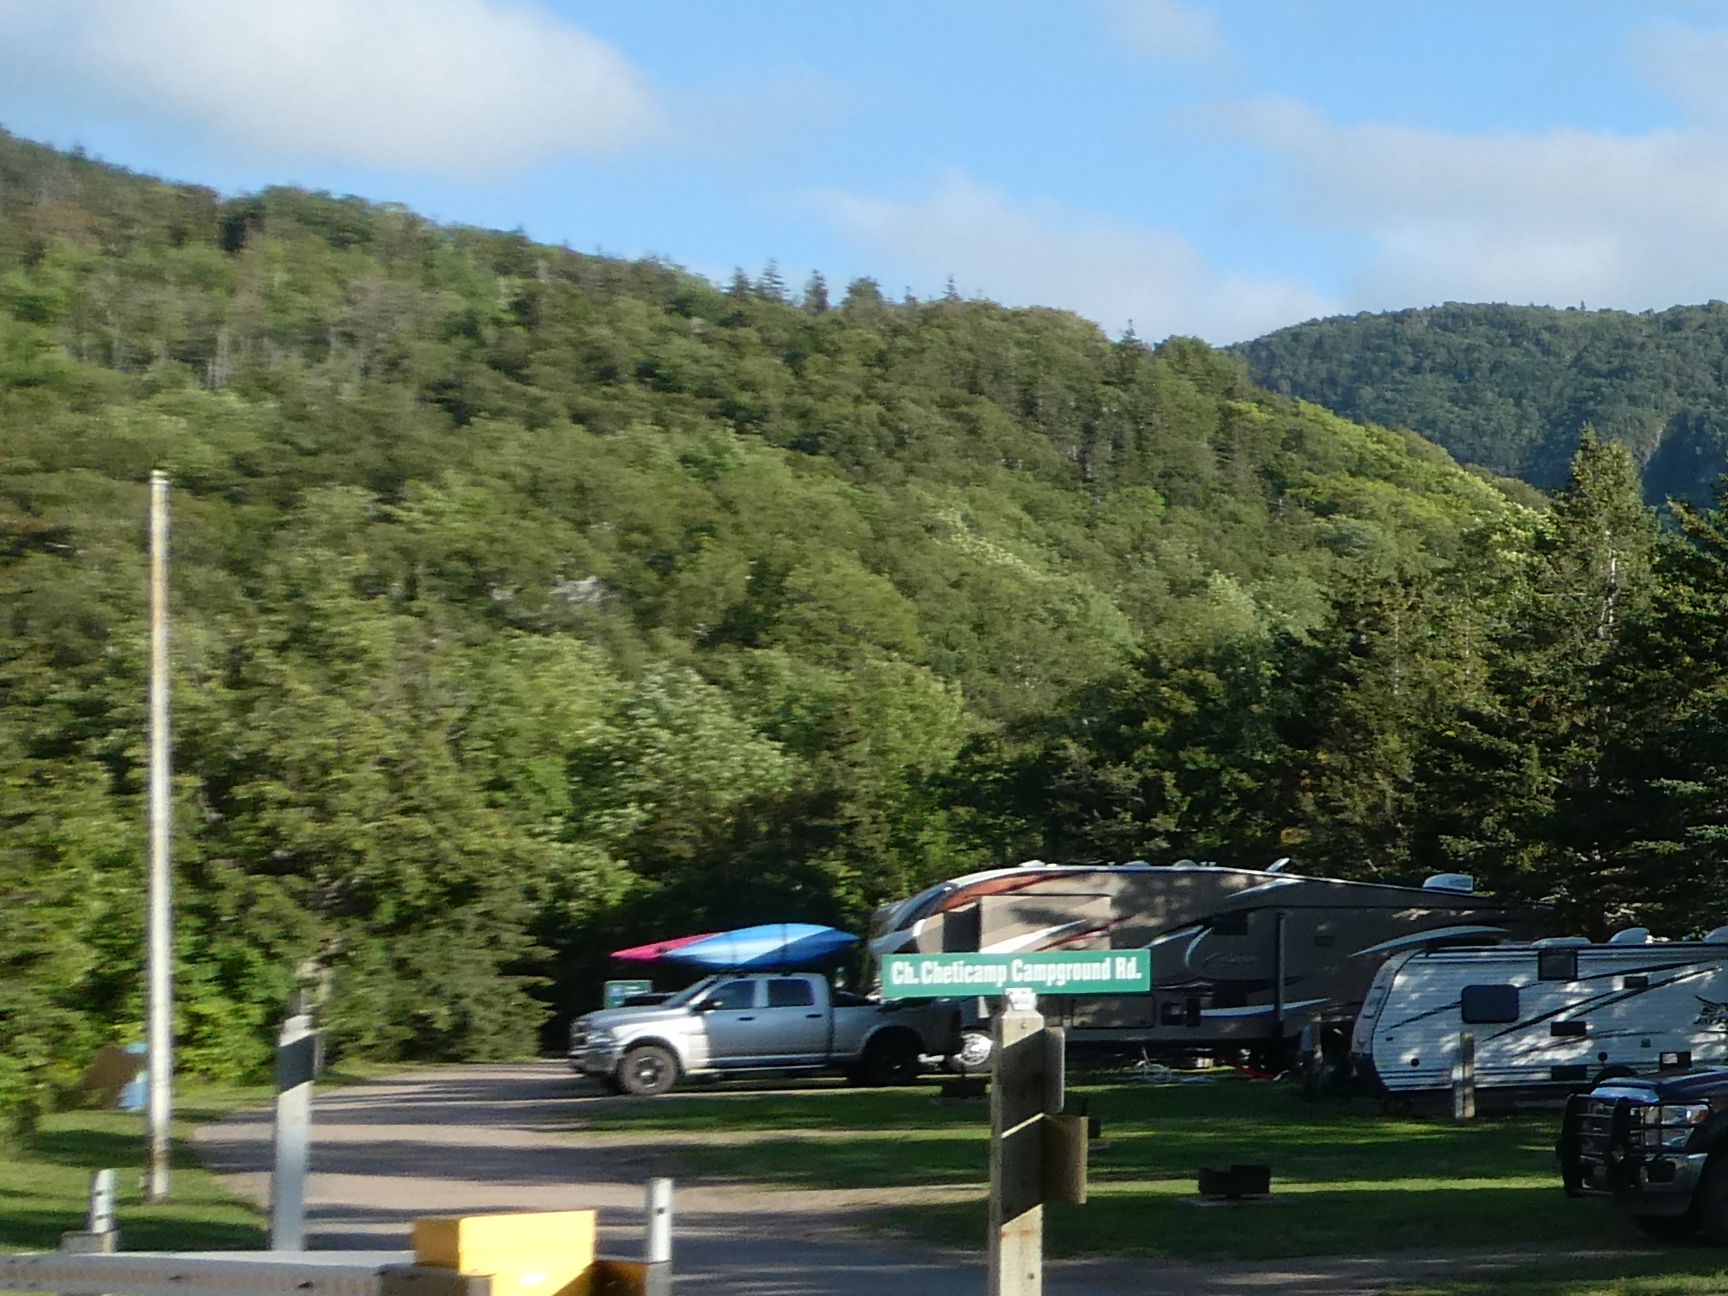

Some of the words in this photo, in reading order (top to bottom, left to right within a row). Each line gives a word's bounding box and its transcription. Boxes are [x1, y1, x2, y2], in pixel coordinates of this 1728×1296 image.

[891, 960, 919, 984] Ch.
[920, 960, 1007, 987] Cheticamp
[1011, 956, 1111, 986] Campground
[1114, 956, 1142, 979] Rd.
